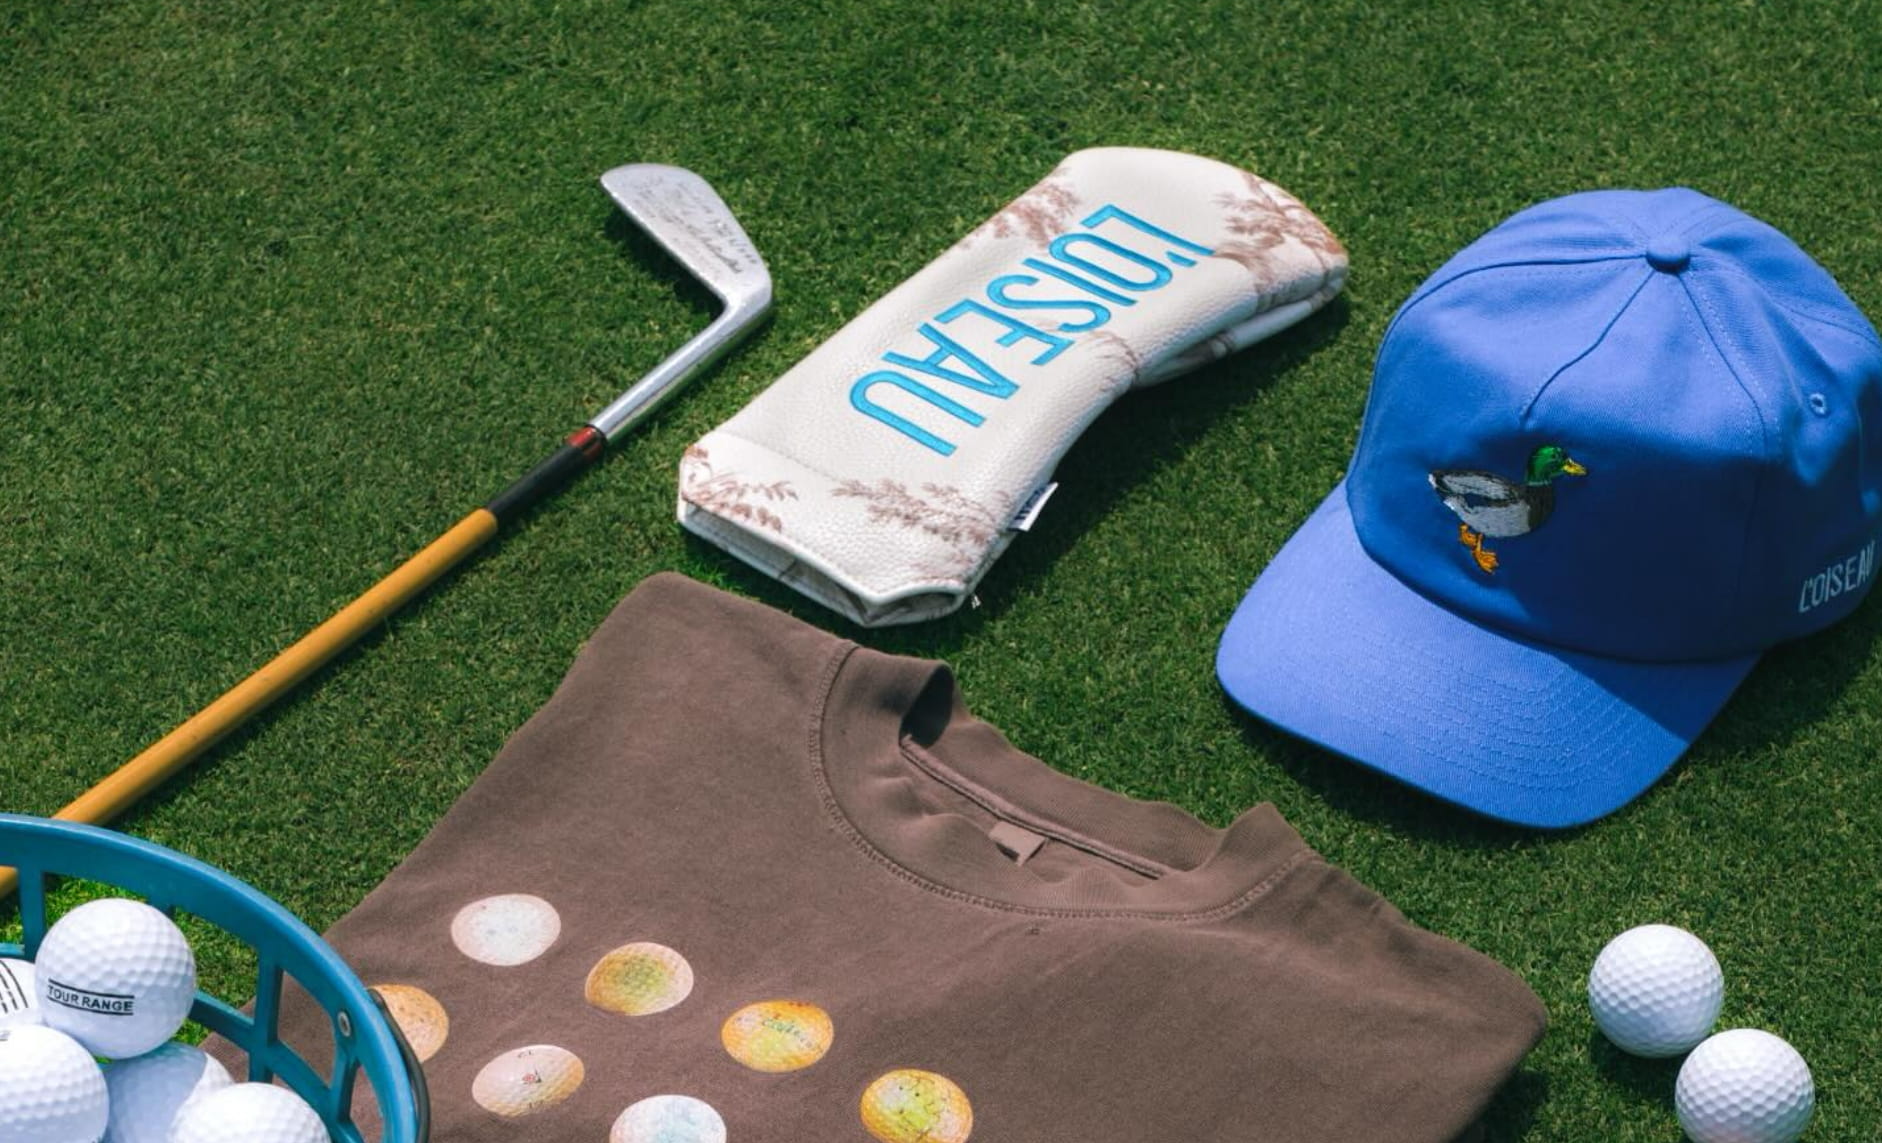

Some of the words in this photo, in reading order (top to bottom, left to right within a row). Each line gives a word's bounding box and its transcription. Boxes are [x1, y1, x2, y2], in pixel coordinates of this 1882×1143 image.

[850, 203, 1214, 457] L'OISEAU
[47, 985, 80, 1005] TOUR
[81, 996, 134, 1012] RANGE
